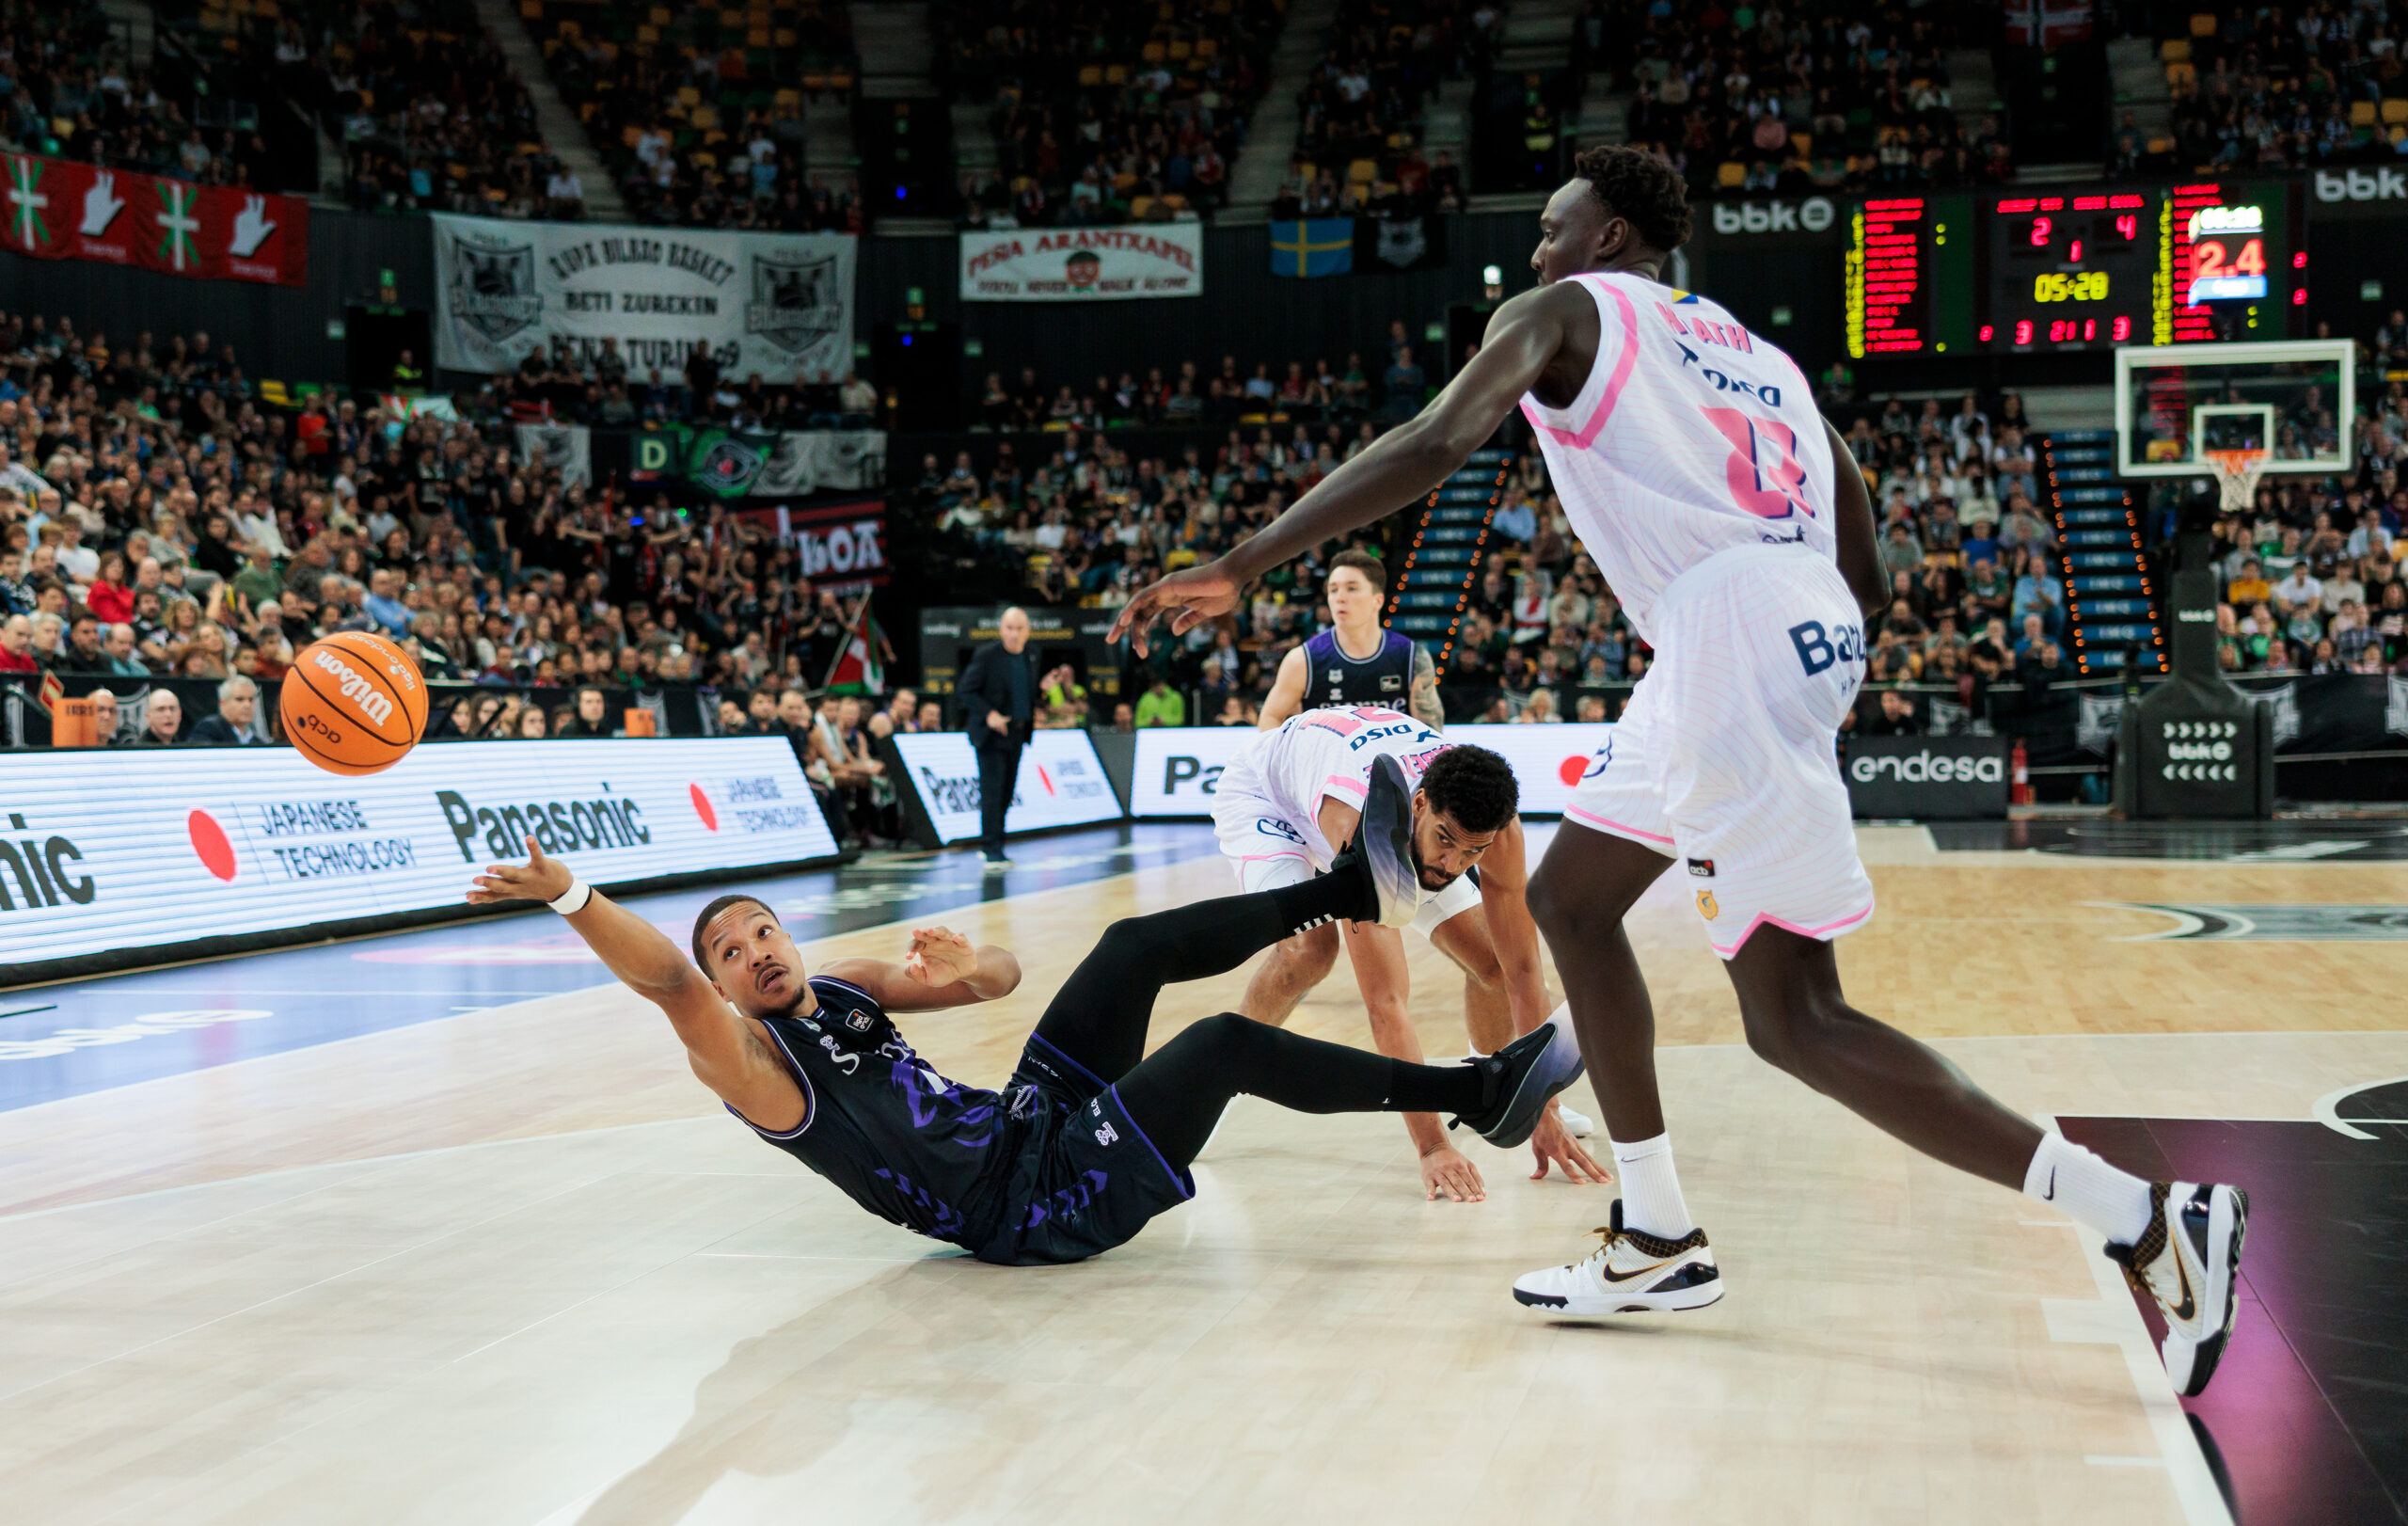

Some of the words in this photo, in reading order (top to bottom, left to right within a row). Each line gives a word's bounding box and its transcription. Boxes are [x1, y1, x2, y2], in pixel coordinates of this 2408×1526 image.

[2315, 167, 2408, 202] bbk
[1713, 199, 1798, 234] bbk
[2031, 216, 2052, 246] 2
[2116, 215, 2137, 241] 4
[2070, 240, 2082, 262] 1
[2198, 239, 2266, 277] 2.4
[566, 292, 611, 311] BETI
[622, 294, 718, 315] ZUREKIN
[2034, 271, 2110, 303] 05:28
[1656, 300, 1753, 355] KATH
[2015, 320, 2034, 345] 3
[2112, 316, 2131, 342] 3
[642, 439, 668, 469] D
[314, 649, 394, 727] Wilson
[307, 713, 342, 745] acb
[1851, 748, 2004, 783] endesa
[261, 800, 369, 836] JAPANESE
[435, 781, 653, 864] Panasonic
[274, 837, 417, 880] TECHNOLOGY
